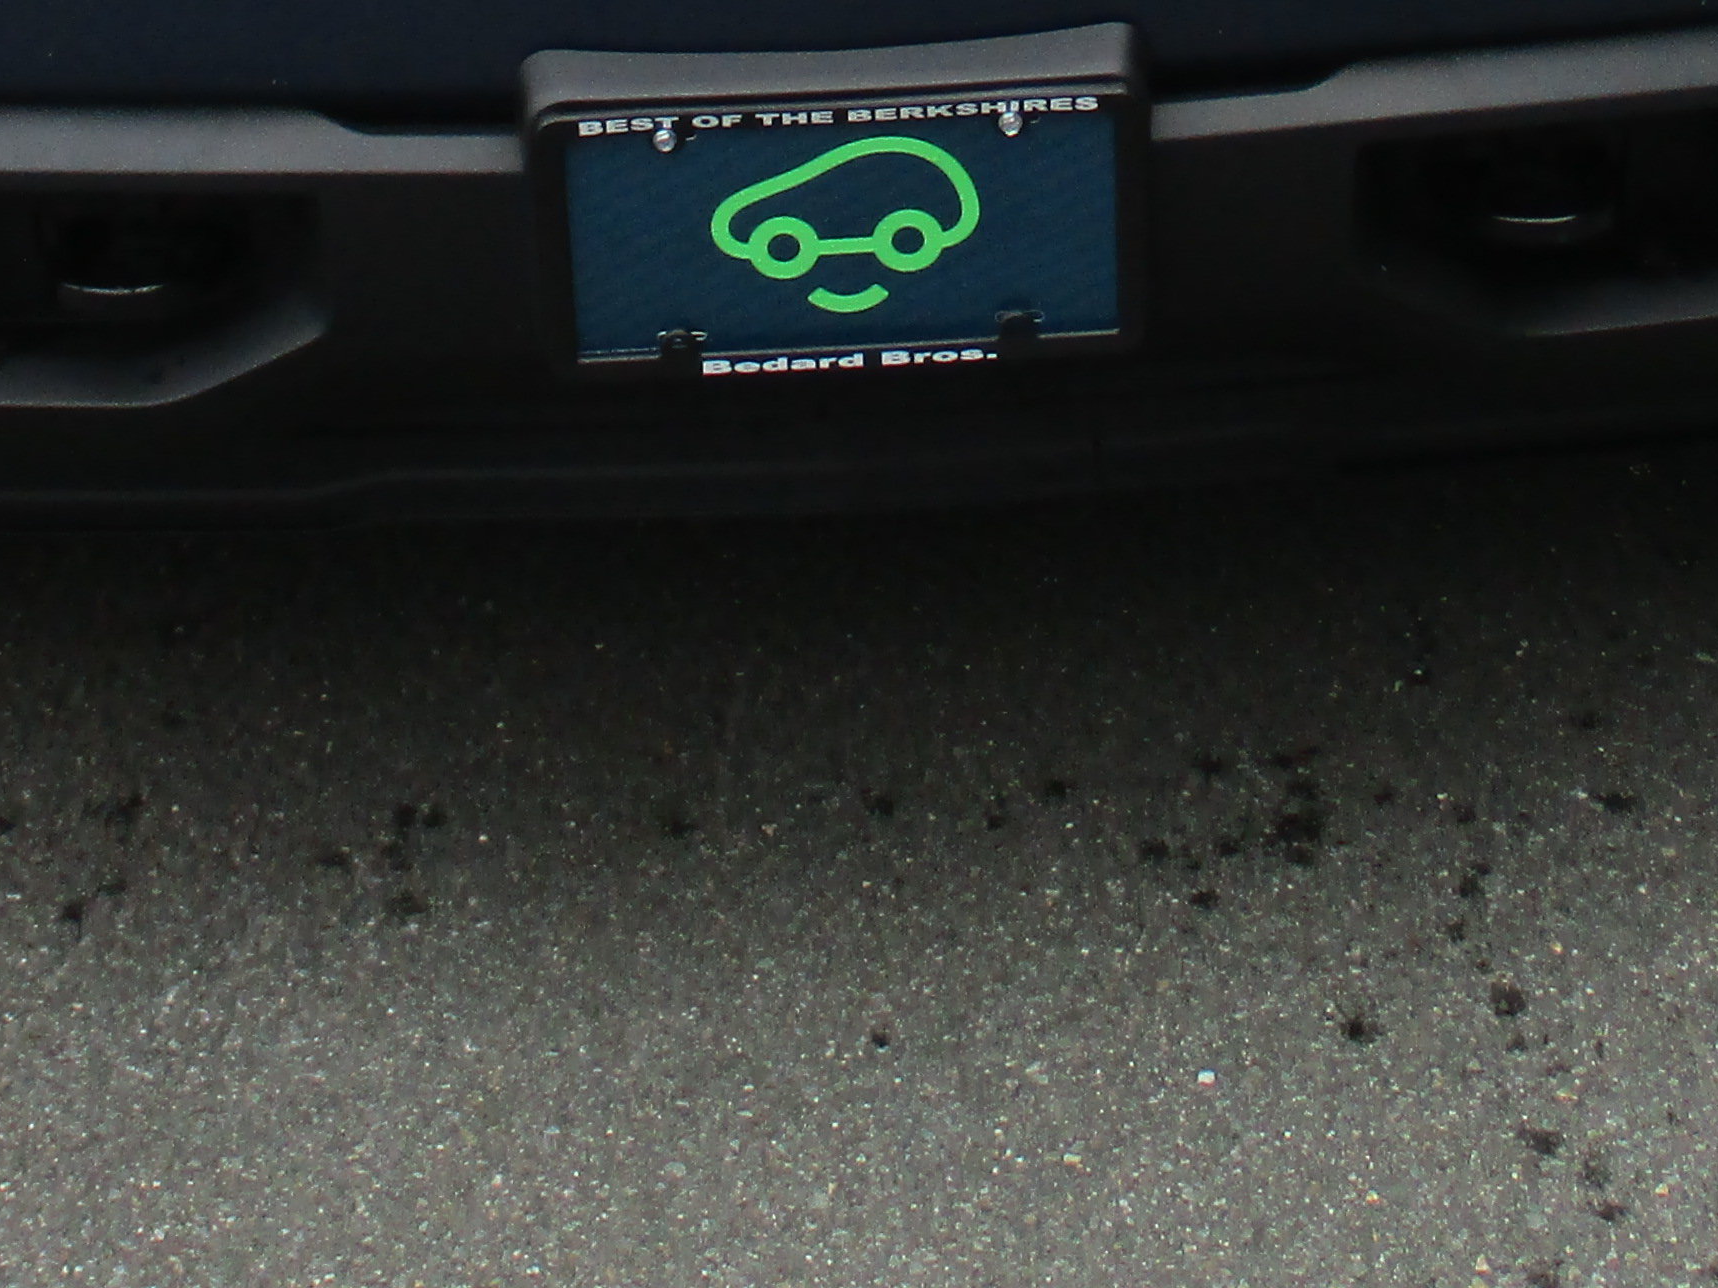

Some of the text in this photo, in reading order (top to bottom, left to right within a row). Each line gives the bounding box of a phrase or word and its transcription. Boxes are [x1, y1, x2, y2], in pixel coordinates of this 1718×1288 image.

[577, 96, 1099, 137] BEST OF THE BERKSHIRES
[881, 348, 998, 366] Bros.
